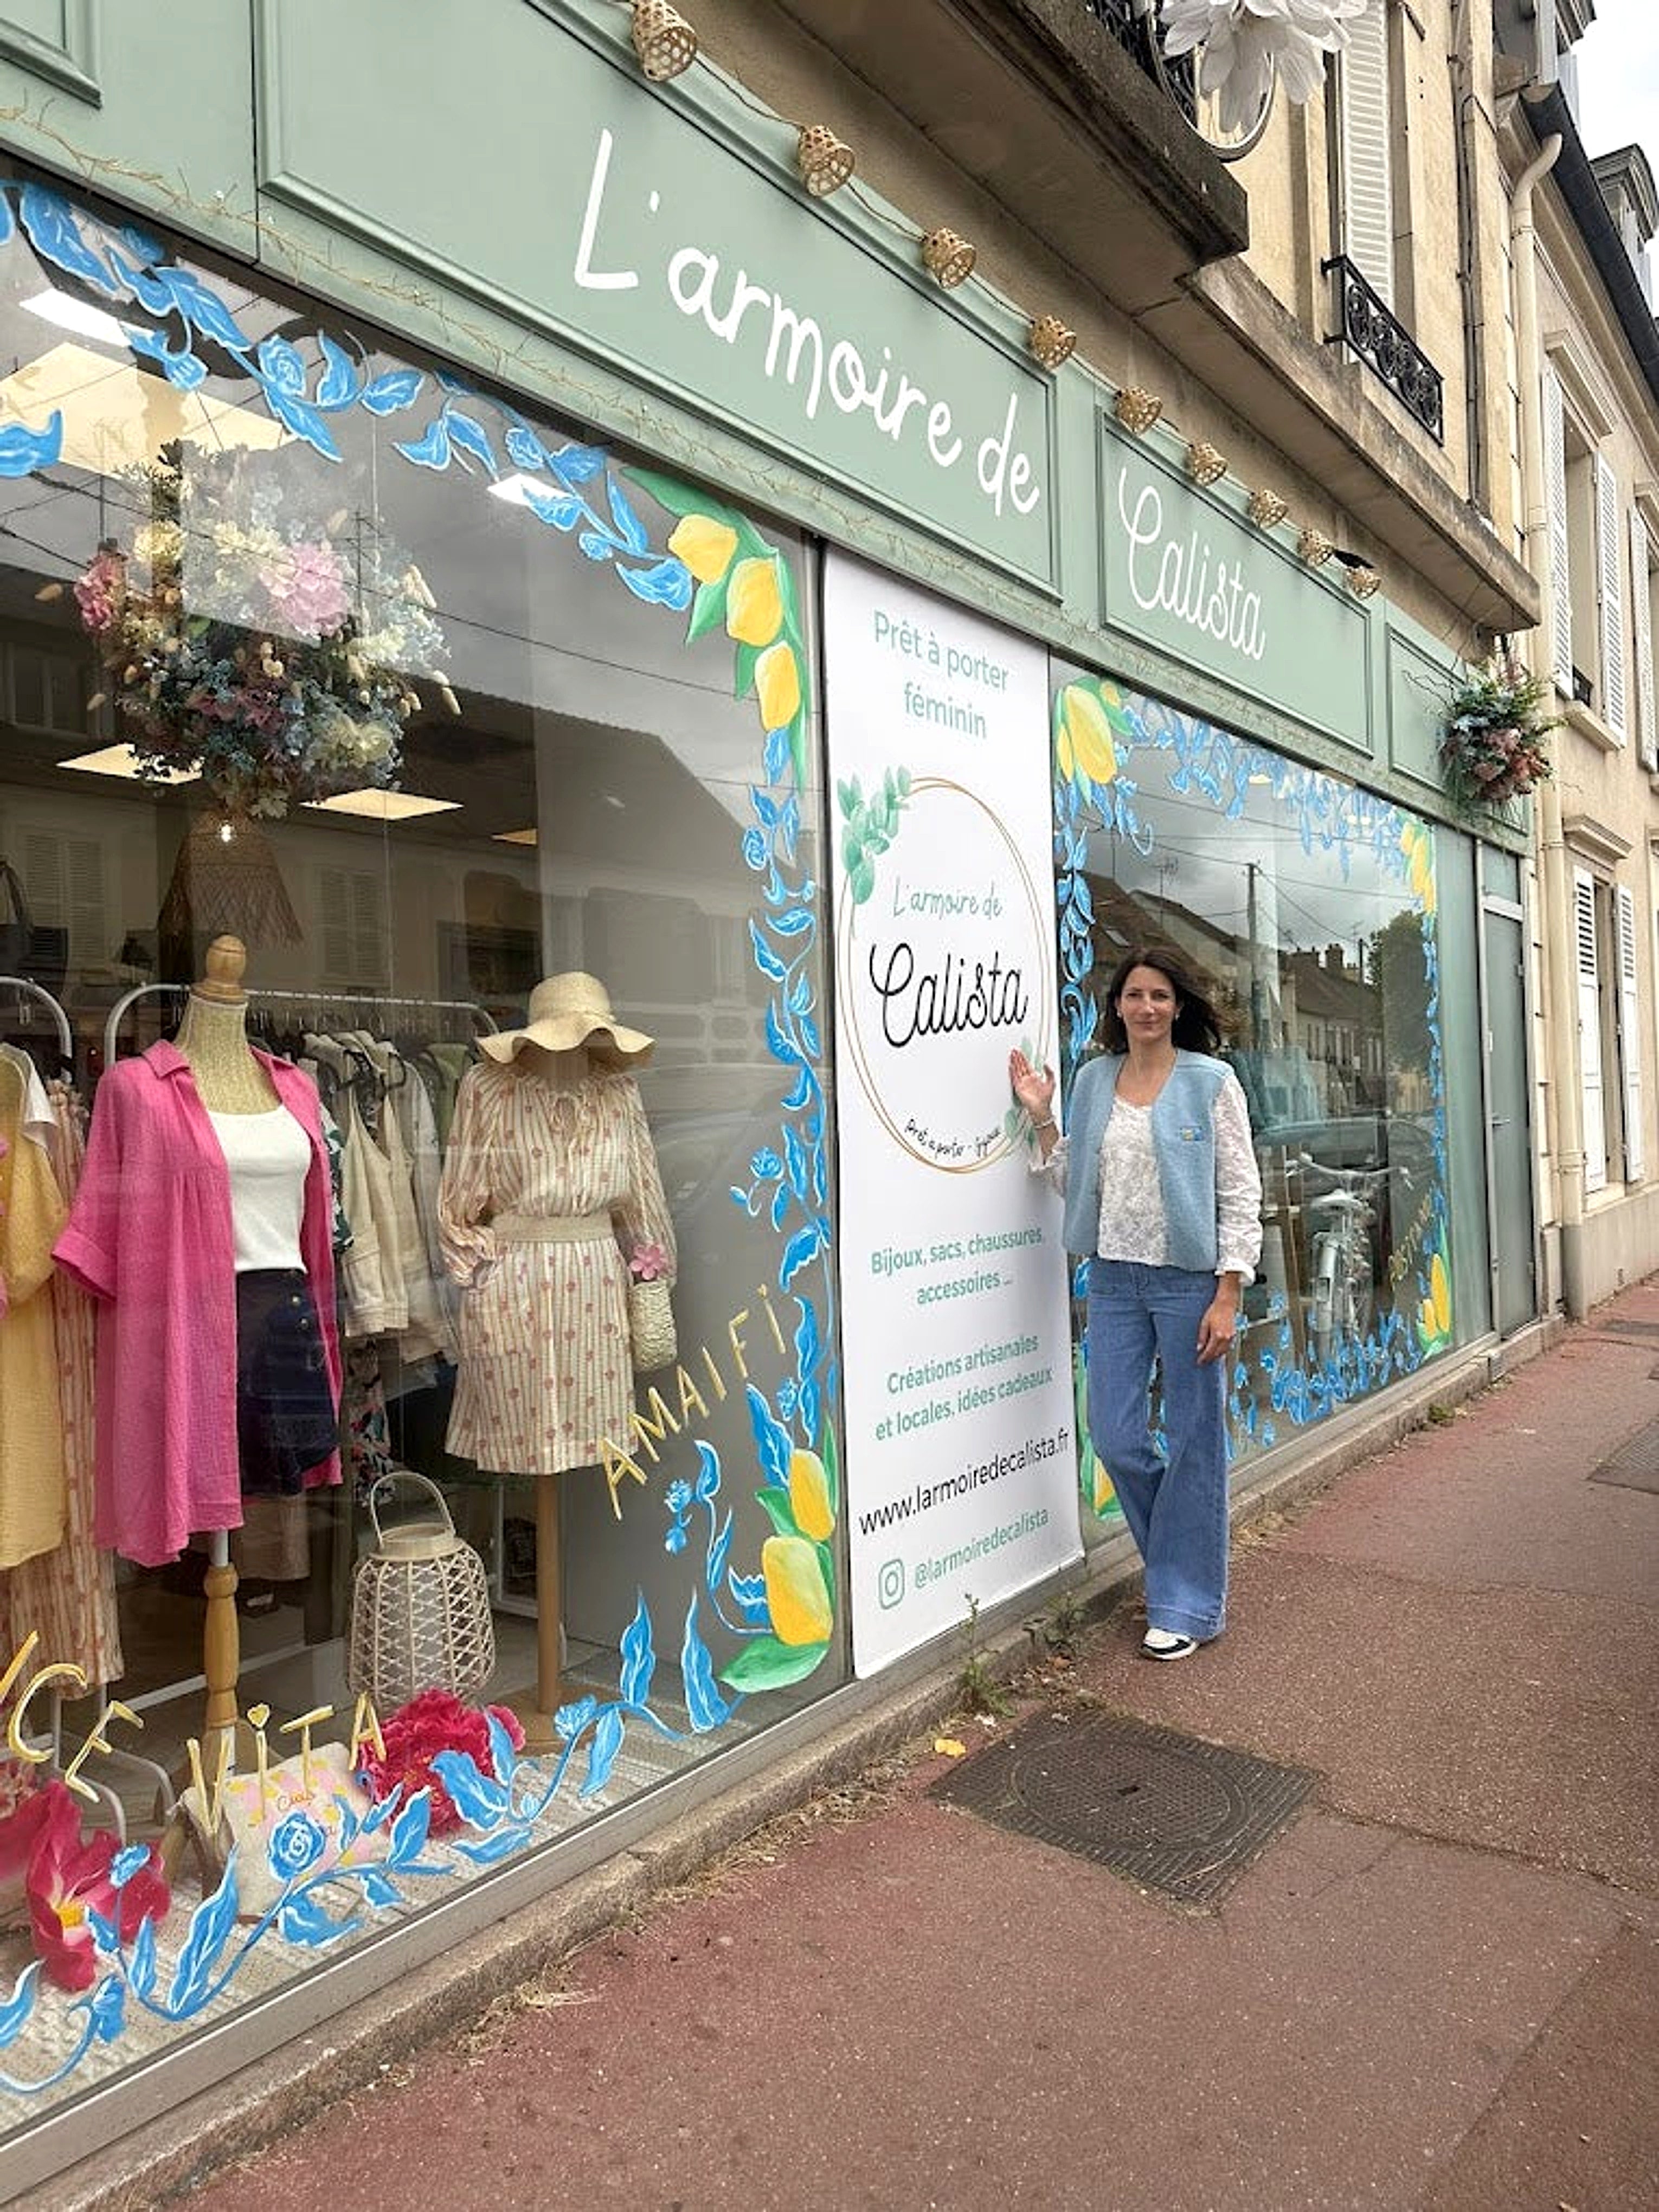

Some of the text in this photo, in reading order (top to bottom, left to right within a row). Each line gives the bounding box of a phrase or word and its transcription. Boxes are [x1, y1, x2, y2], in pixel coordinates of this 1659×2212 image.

[574, 128, 1040, 517] L'armoire de
[1118, 467, 1266, 660] Calista
[874, 609, 1009, 691] Prêt à porter
[904, 681, 987, 740] féminin
[893, 876, 1003, 920] L'armoire de
[869, 942, 1029, 1047] Calista
[871, 1246, 927, 1276] Bijoux,
[930, 1241, 967, 1262] sacs,
[917, 1270, 1001, 1304] accessoires
[886, 1335, 1040, 1394] Créations artisanales
[875, 1368, 1053, 1441] et locales, idées cadeaux
[859, 1427, 1069, 1535] www.larmoiredecalista.fr
[915, 1507, 1049, 1589] @larmoiredecalista
